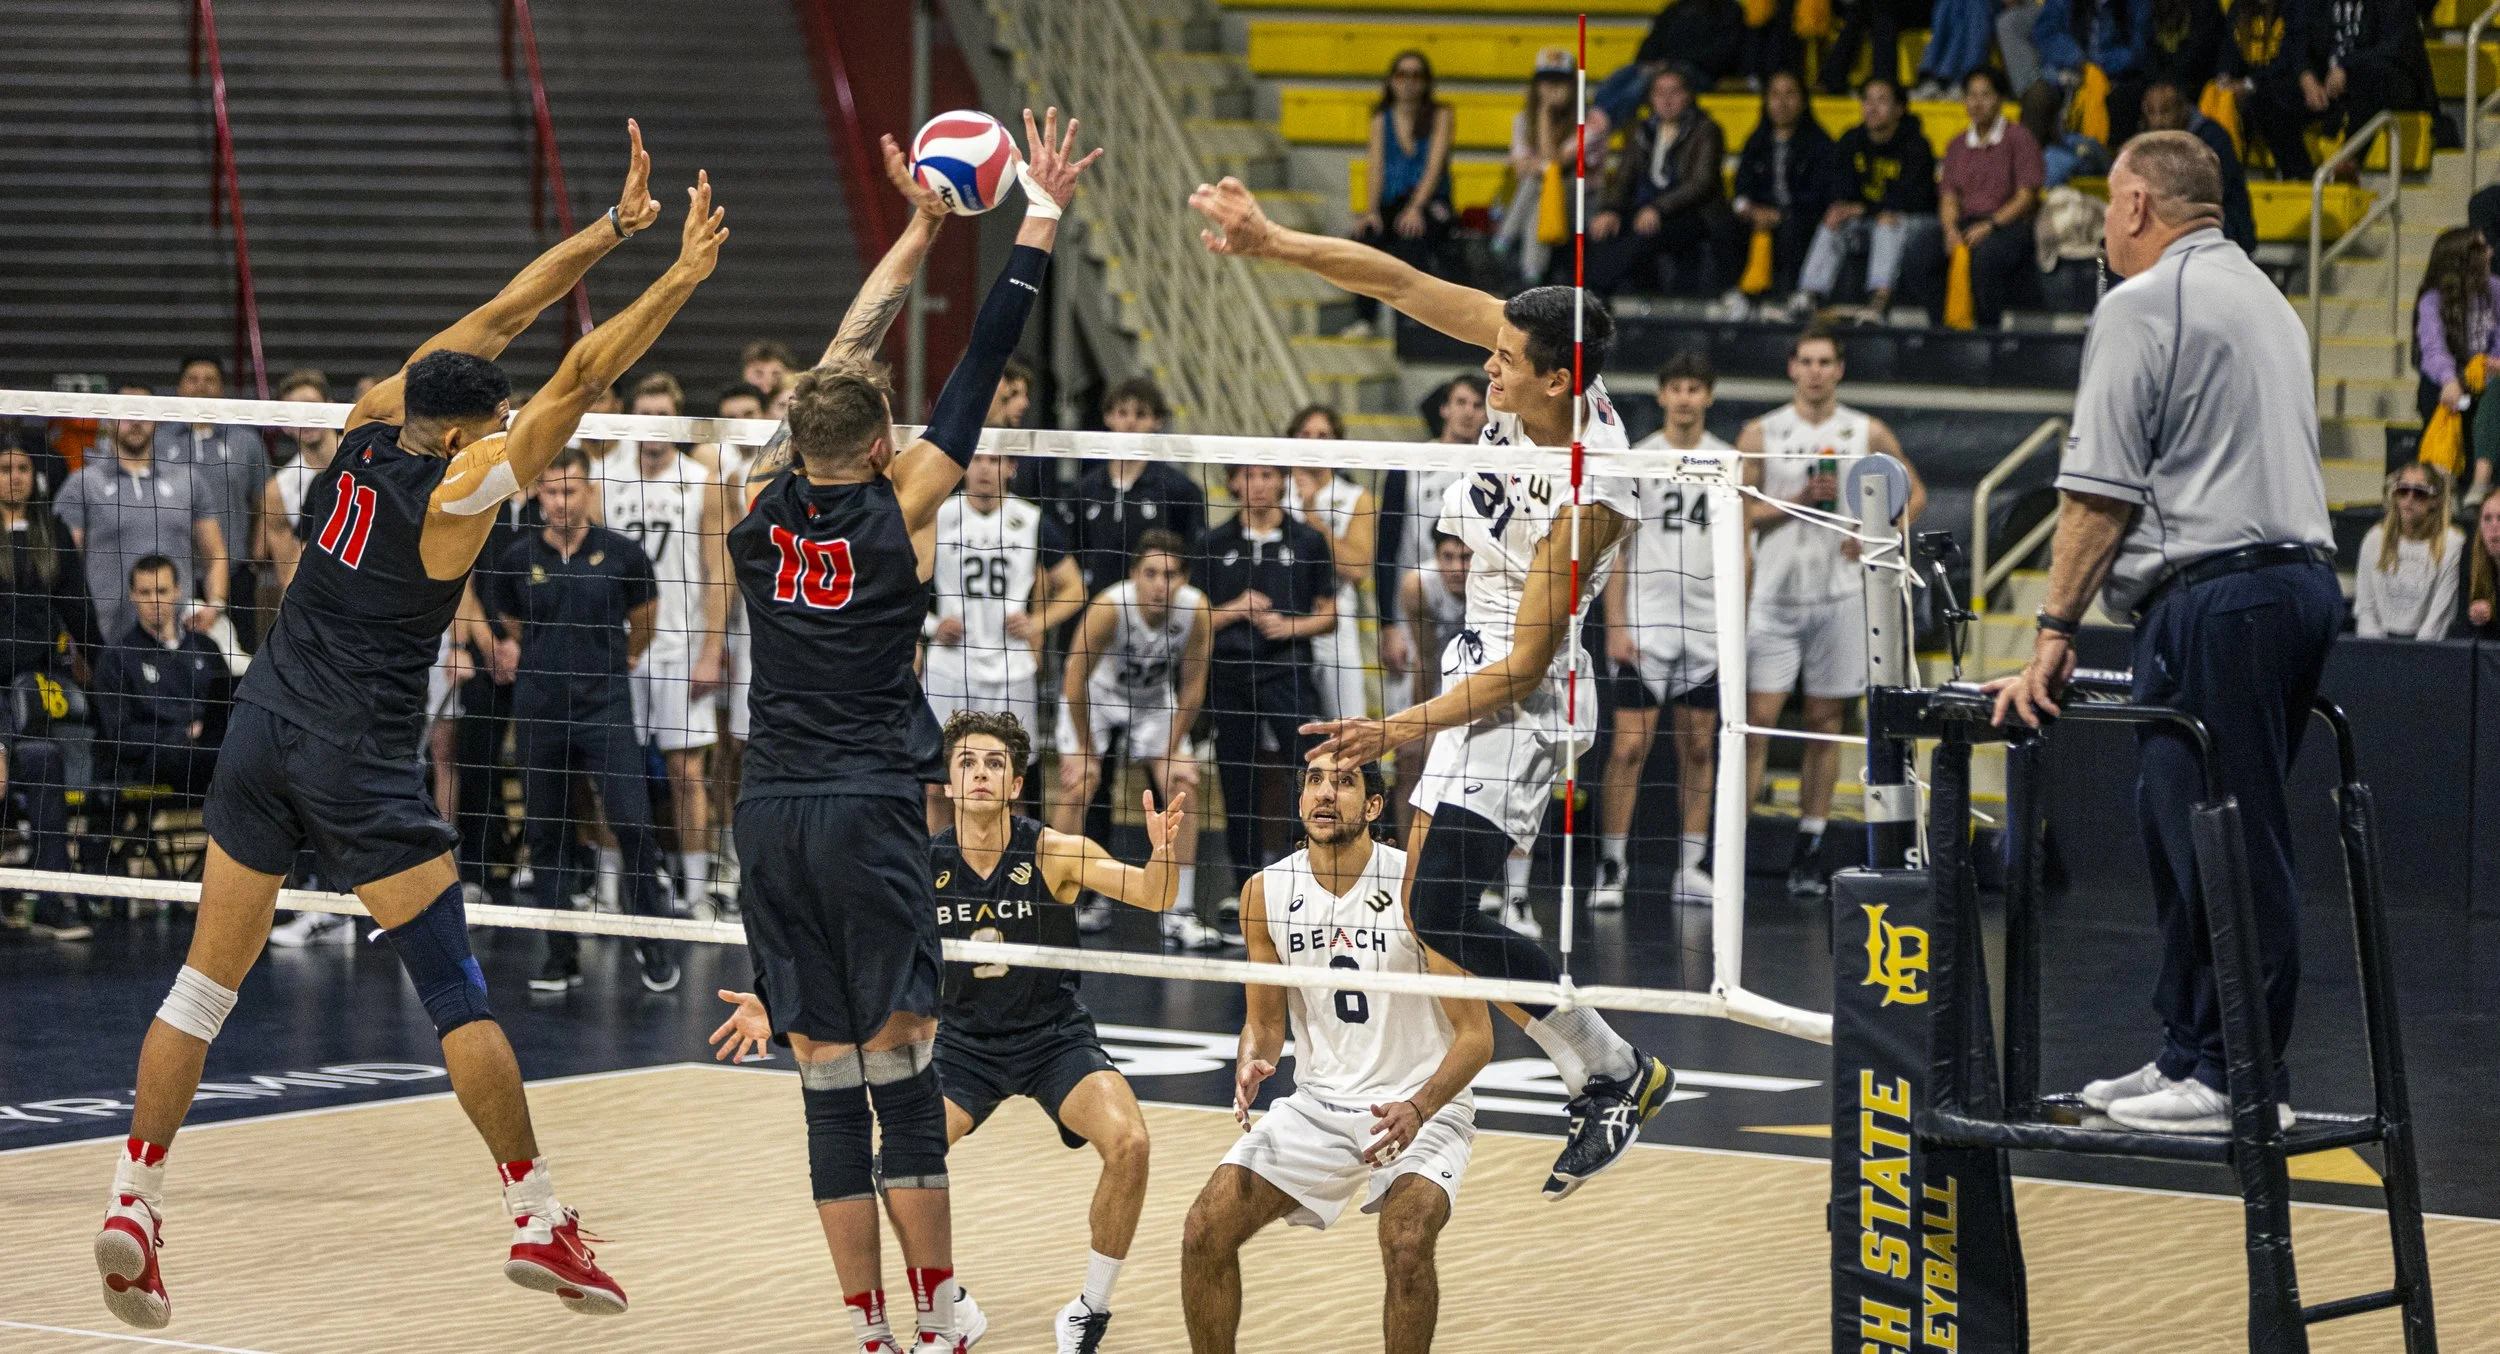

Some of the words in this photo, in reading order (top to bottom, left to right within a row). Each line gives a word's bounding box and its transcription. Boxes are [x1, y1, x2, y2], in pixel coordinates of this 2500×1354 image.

[1690, 457, 1721, 466] Senoh
[318, 470, 377, 570] 11
[1662, 492, 1707, 533] 24
[770, 524, 855, 609] 10
[964, 556, 1009, 598] 26
[936, 900, 1033, 925] BEACH
[1289, 927, 1387, 953] BEACH
[1860, 1069, 1911, 1280] STATE
[1922, 1175, 1958, 1354] EYBALL
